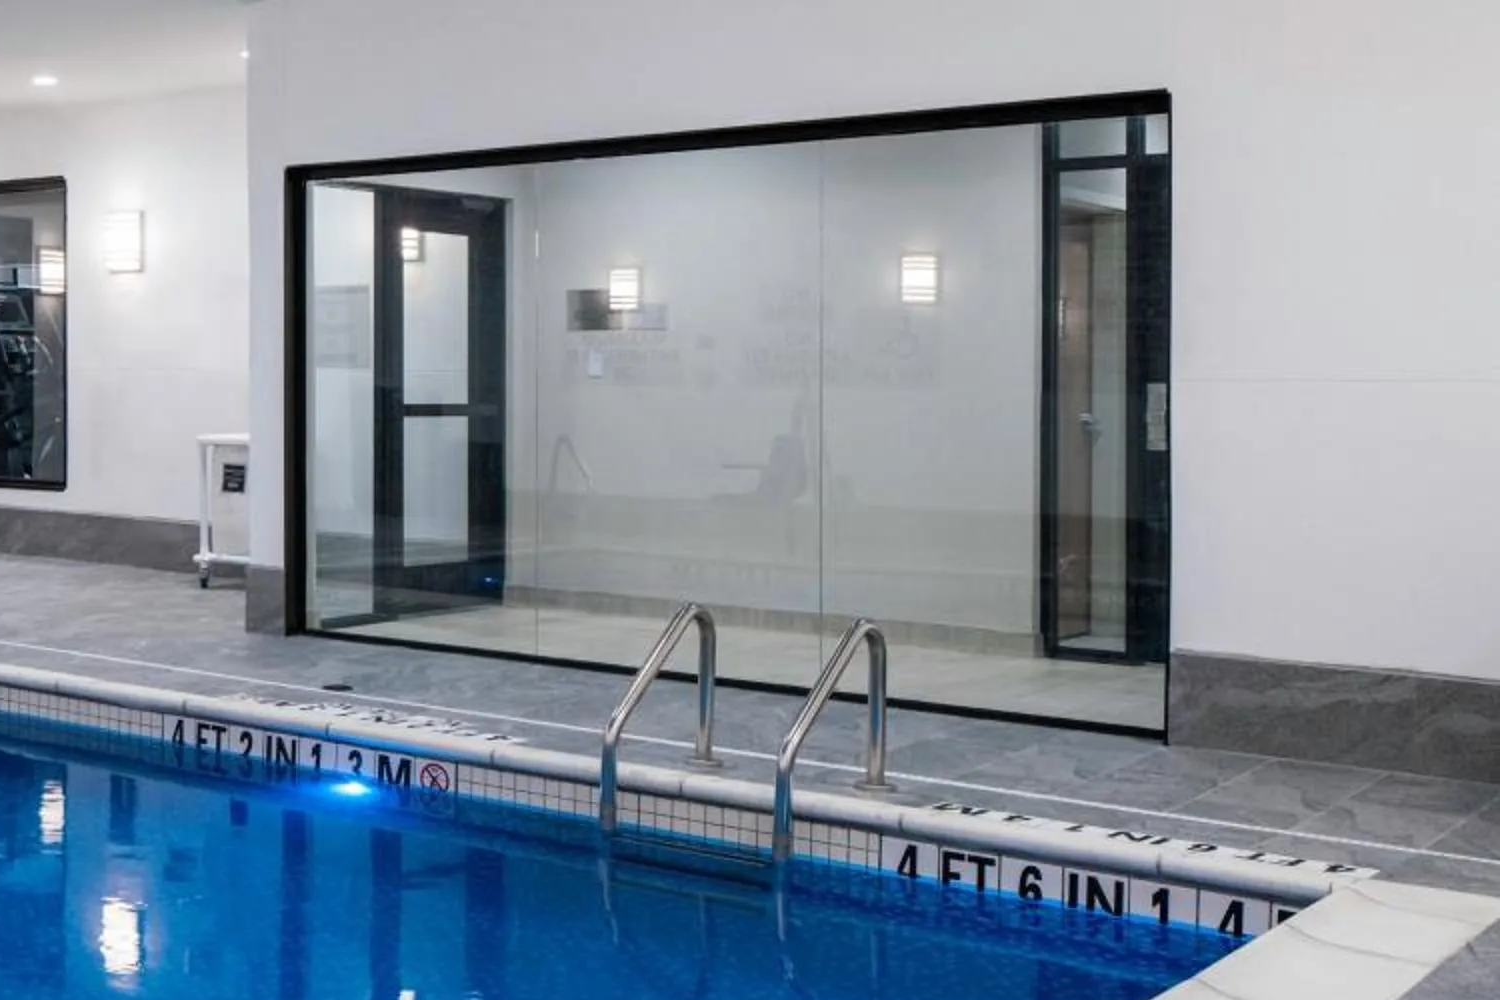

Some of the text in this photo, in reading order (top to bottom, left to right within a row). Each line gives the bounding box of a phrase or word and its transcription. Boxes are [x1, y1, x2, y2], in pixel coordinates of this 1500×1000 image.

[198, 722, 226, 753] FT
[266, 735, 296, 766] IN
[311, 743, 322, 769] 1
[378, 754, 411, 786] M
[897, 844, 918, 879] 4
[942, 850, 996, 892] FT
[1019, 865, 1043, 901] 6
[1067, 872, 1125, 916] IN
[1152, 887, 1170, 925] 1
[1218, 900, 1245, 936] 4
